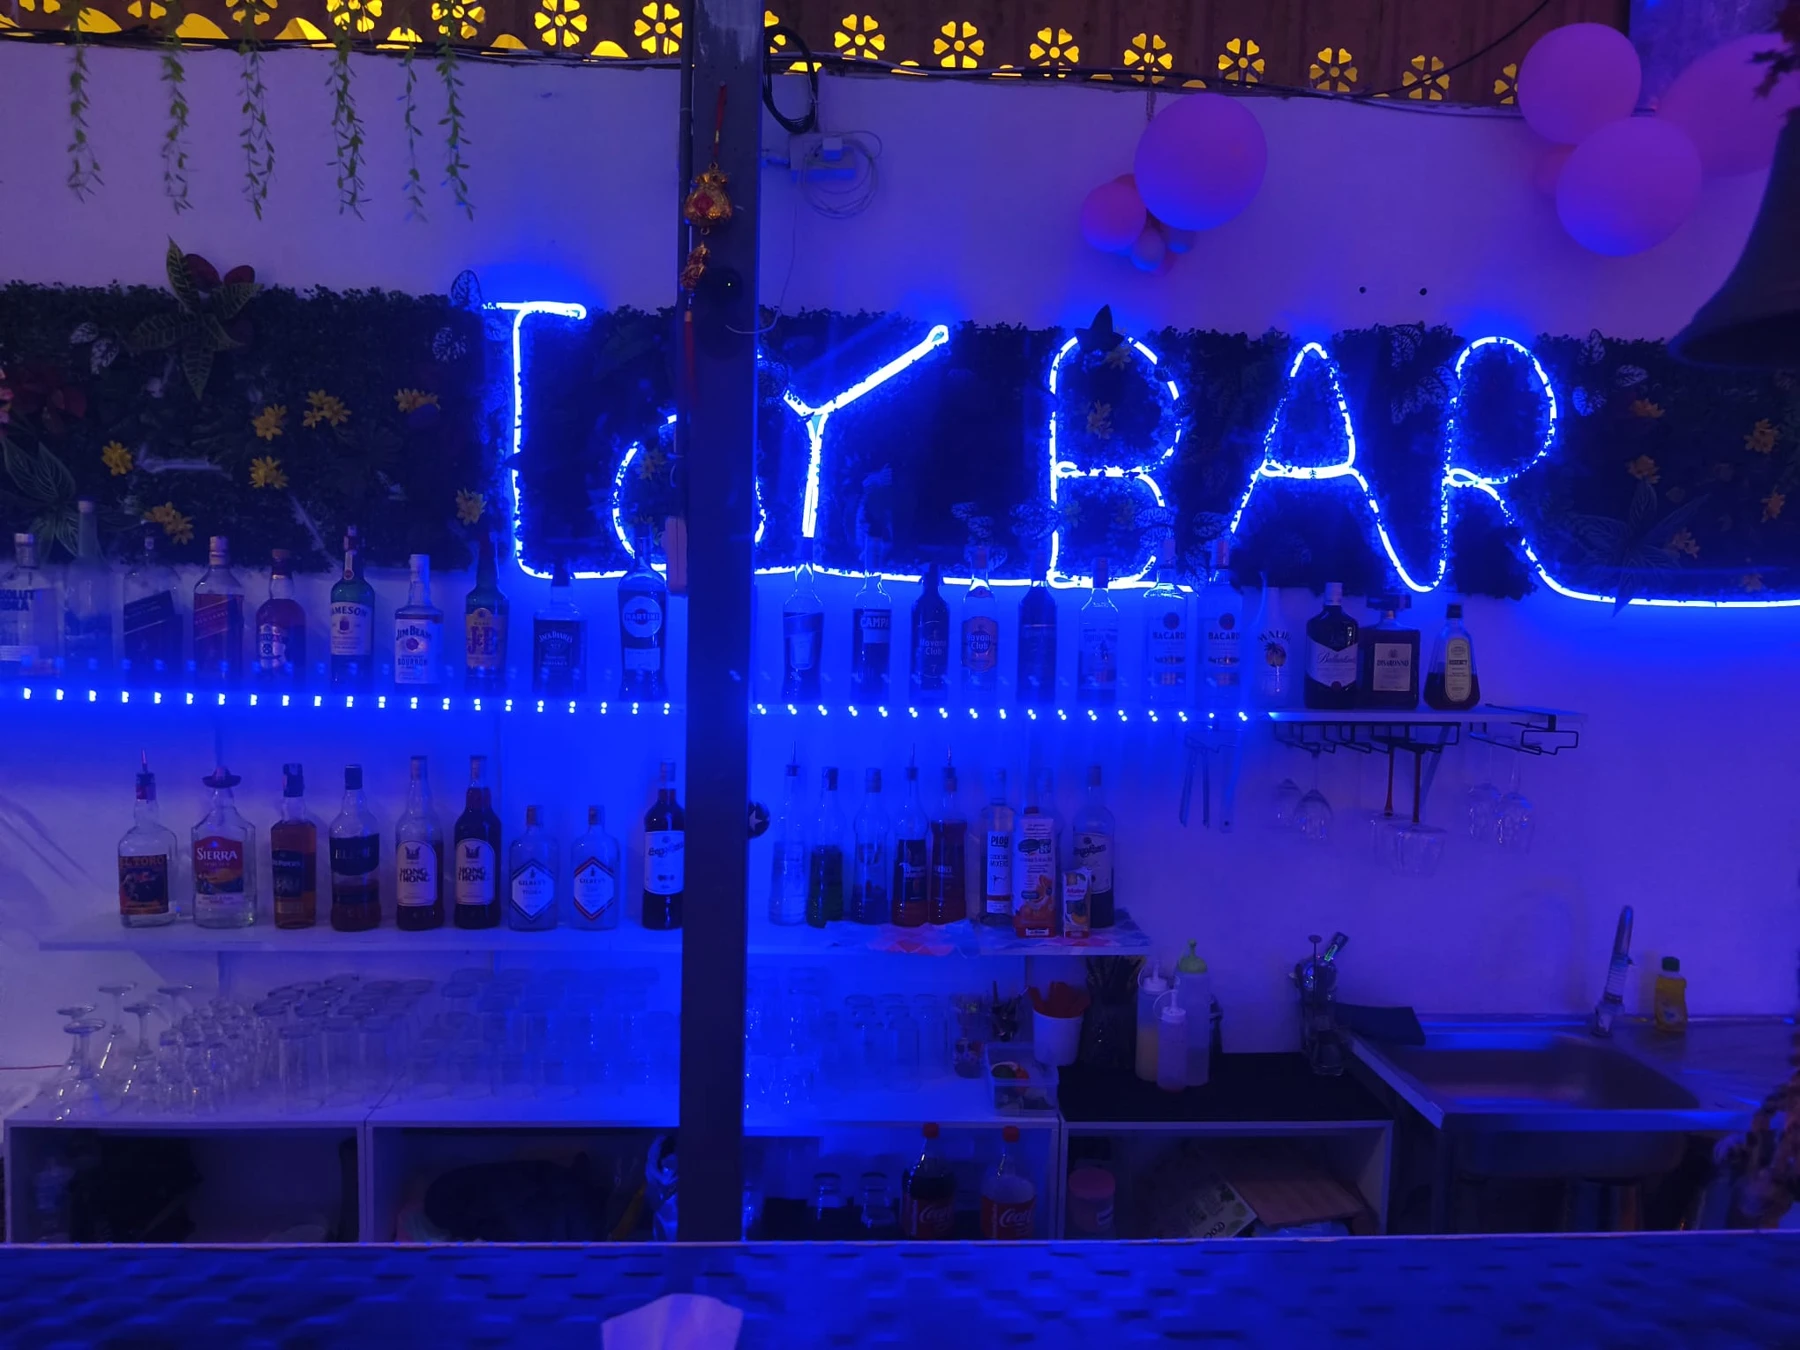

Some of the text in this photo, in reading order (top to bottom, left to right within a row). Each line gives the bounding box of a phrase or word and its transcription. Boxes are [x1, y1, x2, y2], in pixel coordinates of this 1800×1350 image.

[1047, 334, 1560, 592] BAR
[331, 605, 367, 617] AMESON
[625, 612, 659, 621] MARTINI
[396, 625, 432, 641] JIM BEAM
[1153, 632, 1186, 640] BACARD
[1208, 632, 1241, 640] BACARD
[196, 846, 238, 861] SIERRA
[400, 867, 428, 876] HONG
